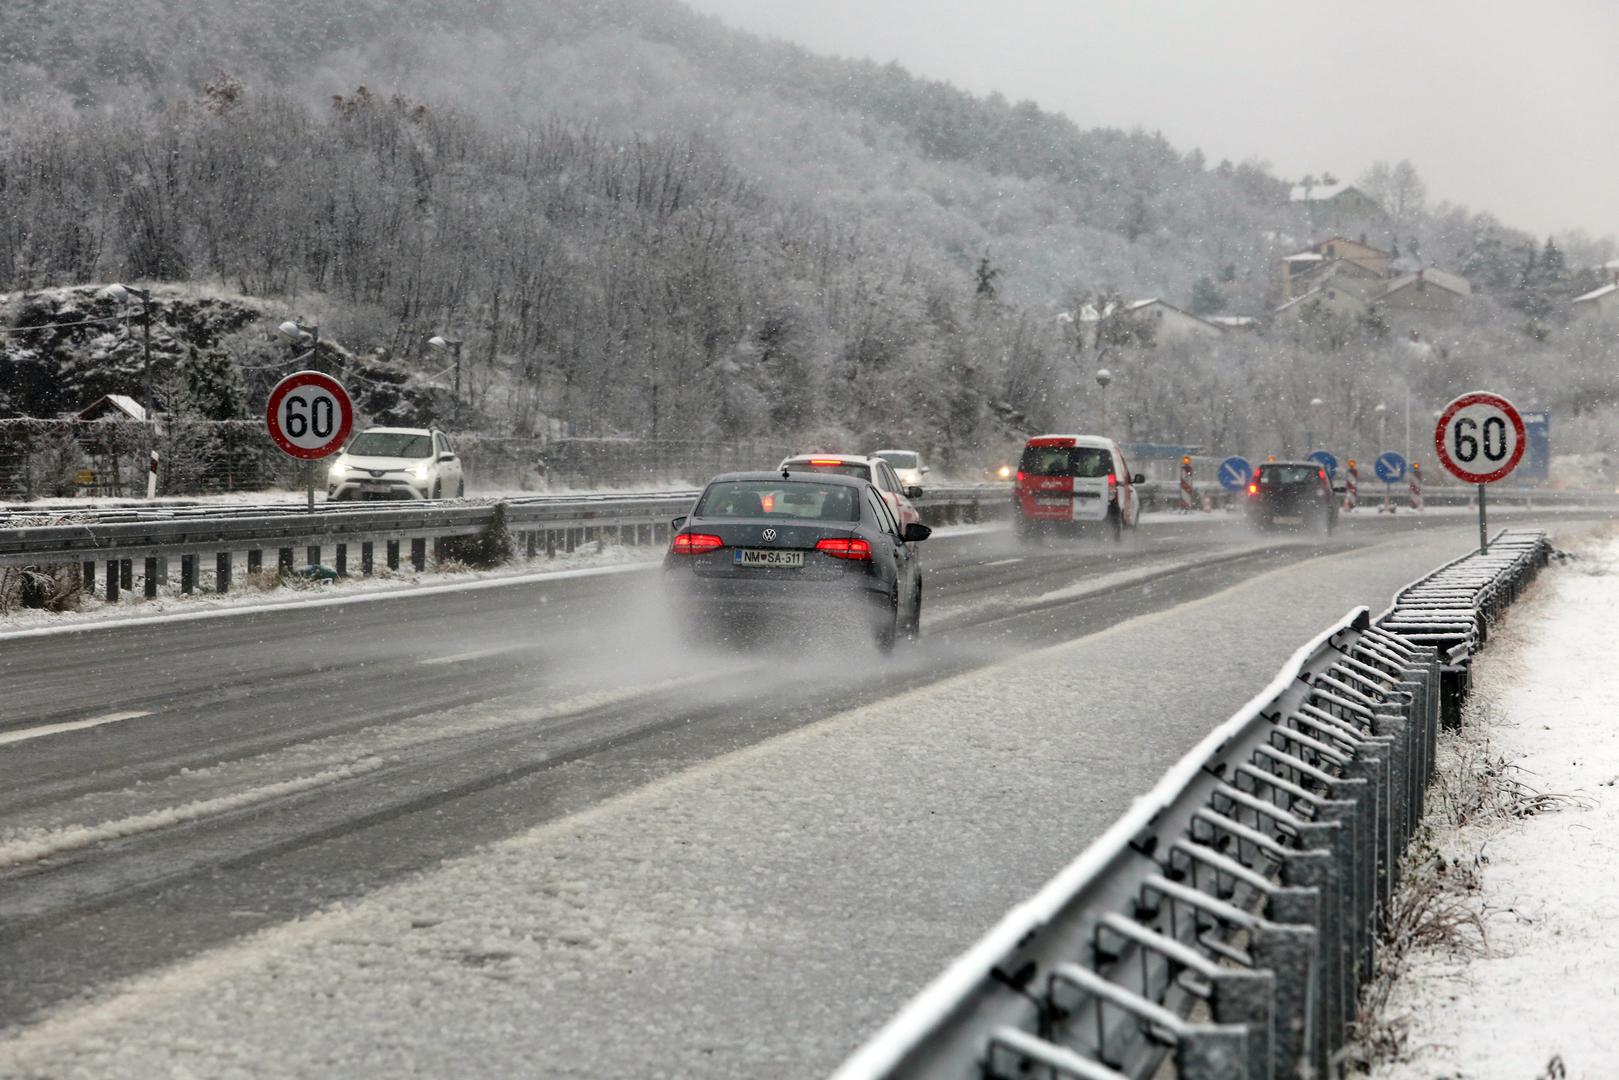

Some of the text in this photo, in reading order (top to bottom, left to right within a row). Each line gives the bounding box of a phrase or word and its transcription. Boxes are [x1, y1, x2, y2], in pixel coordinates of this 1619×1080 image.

[285, 395, 333, 438] 60
[1454, 416, 1507, 463] 60
[744, 551, 760, 563] NM
